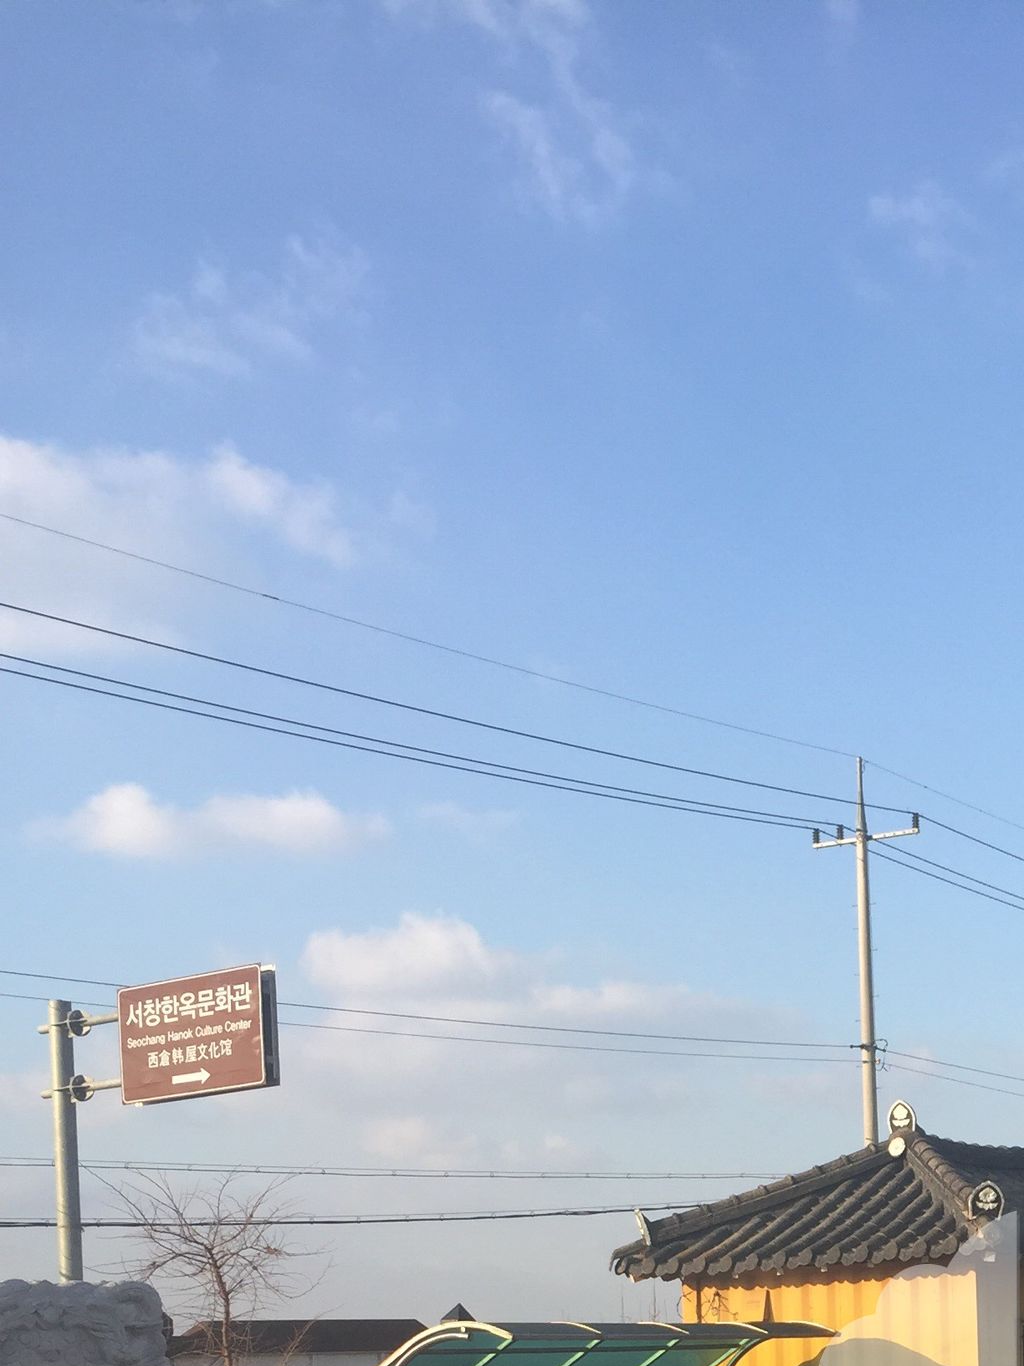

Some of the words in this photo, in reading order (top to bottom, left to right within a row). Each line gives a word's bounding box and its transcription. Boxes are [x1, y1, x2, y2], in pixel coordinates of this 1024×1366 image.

[126, 982, 253, 1028] 서창한옥문화관
[127, 1034, 166, 1049] Seochang
[167, 1028, 194, 1041] Hanok
[195, 1023, 223, 1037] Culture
[224, 1019, 252, 1032] Center
